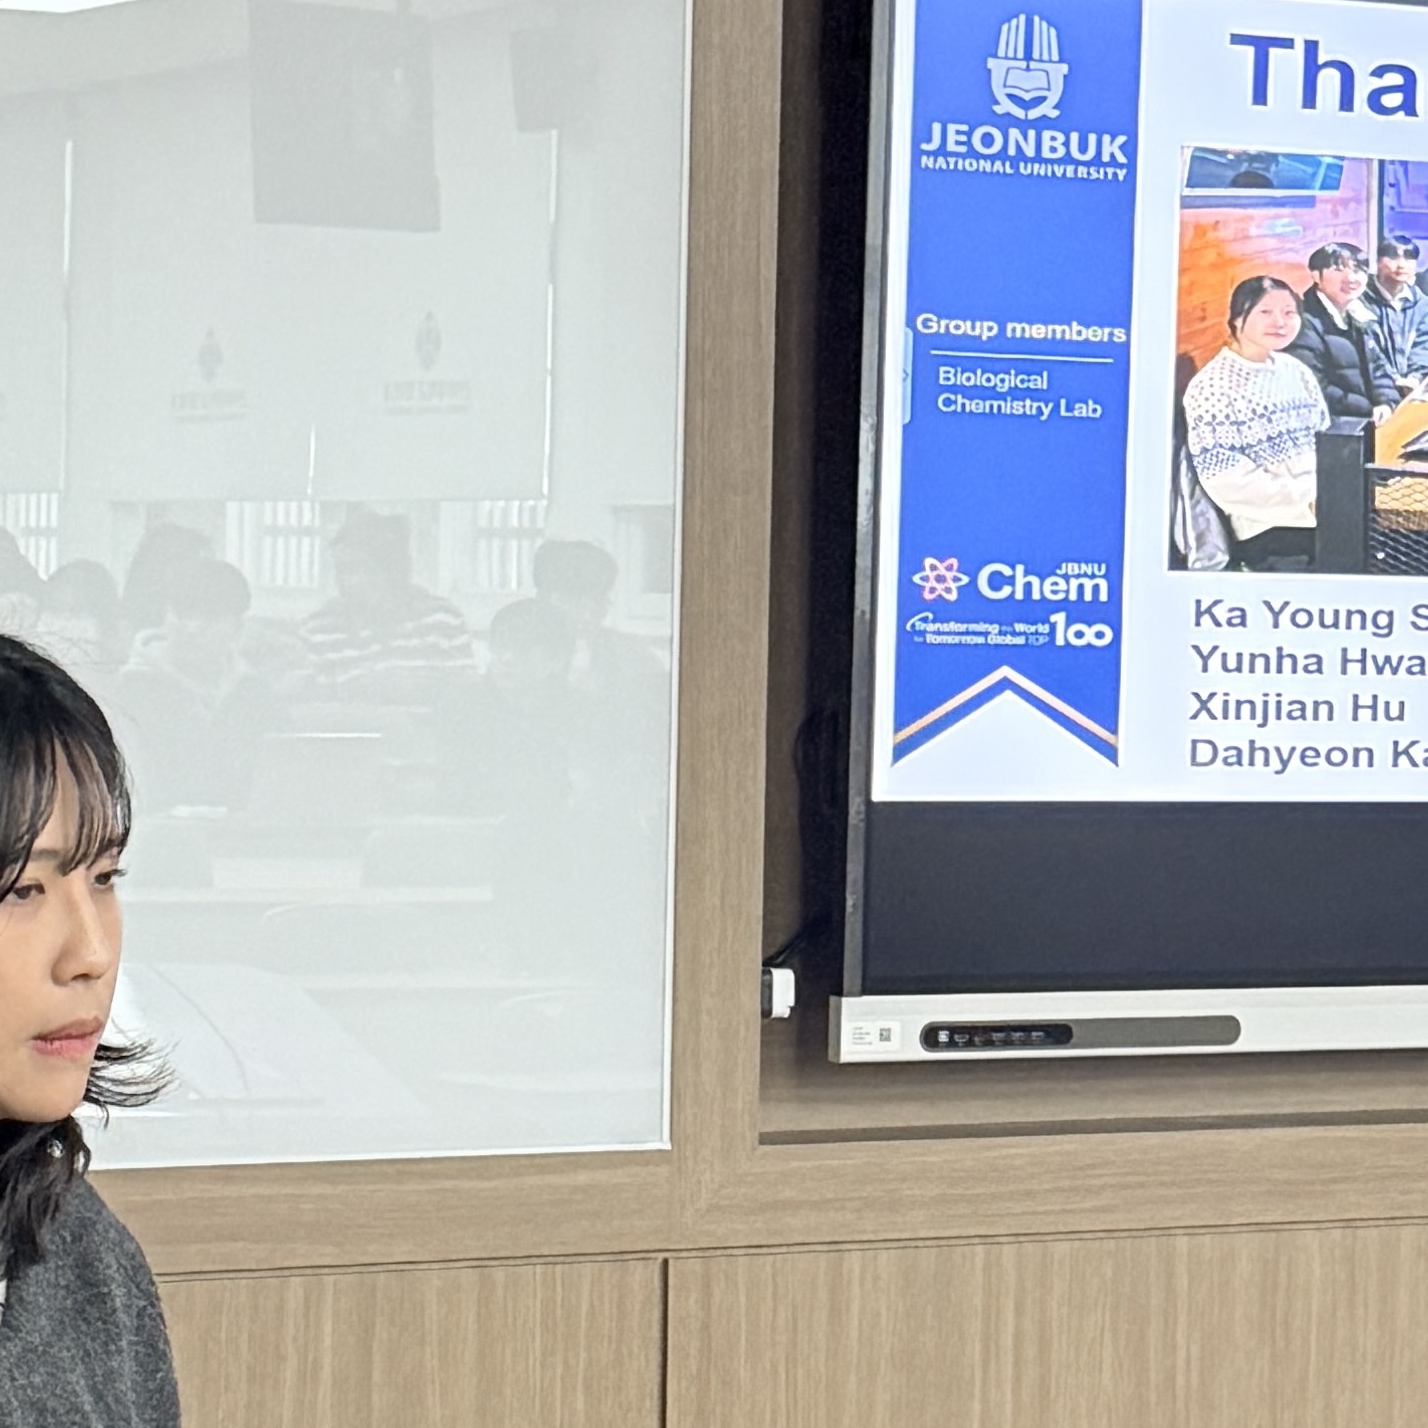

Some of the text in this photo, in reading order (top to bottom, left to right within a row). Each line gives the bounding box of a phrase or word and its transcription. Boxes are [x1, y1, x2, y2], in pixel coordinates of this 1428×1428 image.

[920, 122, 1128, 165] JEONBUK
[920, 155, 1127, 182] NATIONAL UNIVERSITY
[916, 313, 1127, 349] Group members
[938, 366, 1048, 392] Biological
[937, 394, 1103, 420] Chemistry Lab
[977, 562, 1109, 602] Chem
[1056, 562, 1106, 576] JBNU
[1192, 600, 1248, 631] Ka
[1261, 601, 1395, 639] Young
[1192, 646, 1326, 678] Yunha
[1189, 692, 1407, 730] Xinjian Hu
[1189, 738, 1379, 776] Dahyeon
